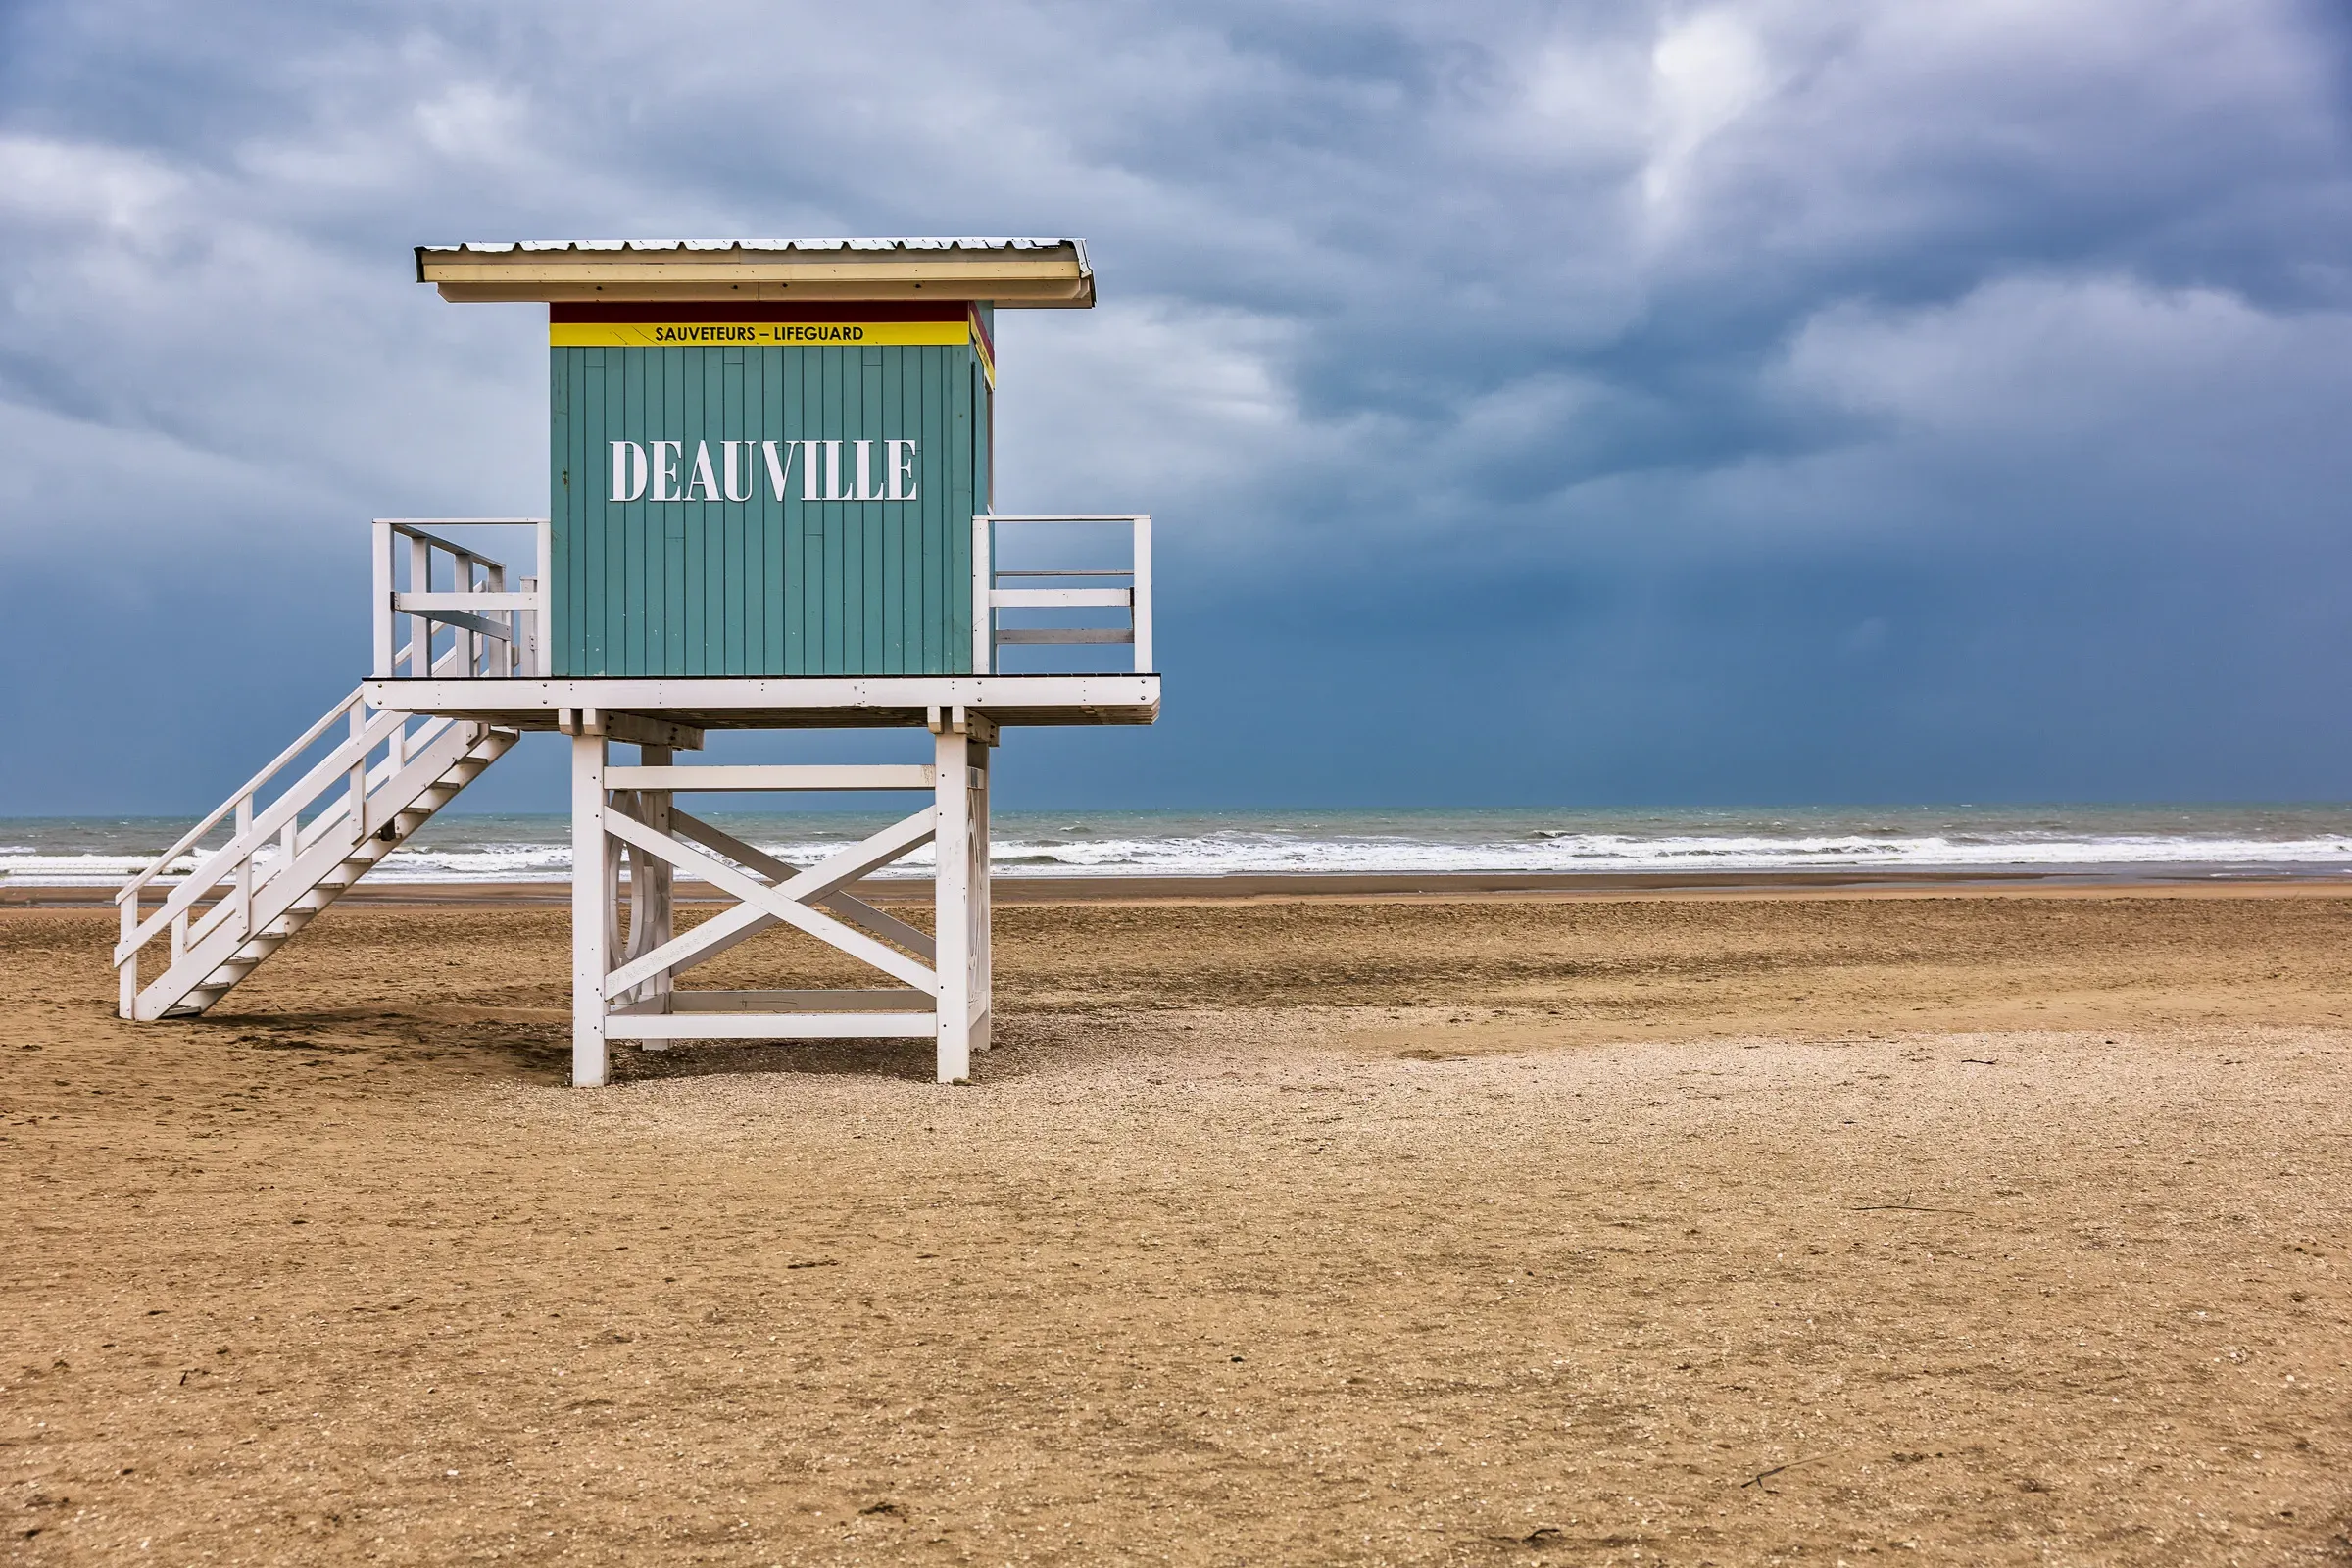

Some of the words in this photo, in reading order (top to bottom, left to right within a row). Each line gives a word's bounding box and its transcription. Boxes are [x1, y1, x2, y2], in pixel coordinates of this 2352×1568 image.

[655, 326, 756, 341] SAUVETEURS
[774, 326, 864, 341] LIFEGUARD
[609, 439, 917, 502] DEAUVILLE
